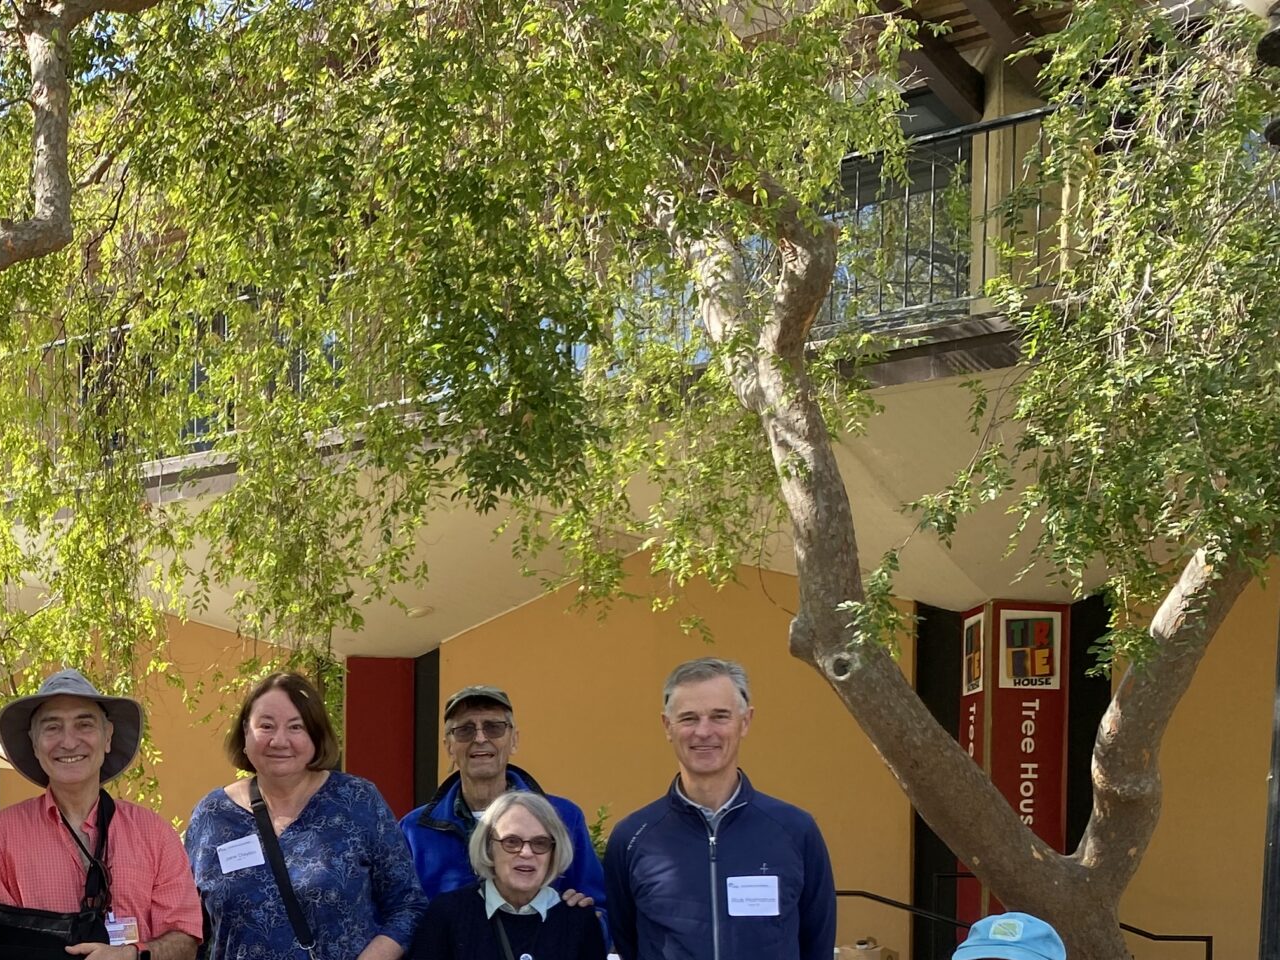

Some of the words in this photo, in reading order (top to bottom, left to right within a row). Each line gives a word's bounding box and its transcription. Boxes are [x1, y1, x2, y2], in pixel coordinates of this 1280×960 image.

[1013, 677, 1052, 687] HOUSE
[1021, 698, 1040, 754] Tree
[1019, 763, 1039, 826] Hous
